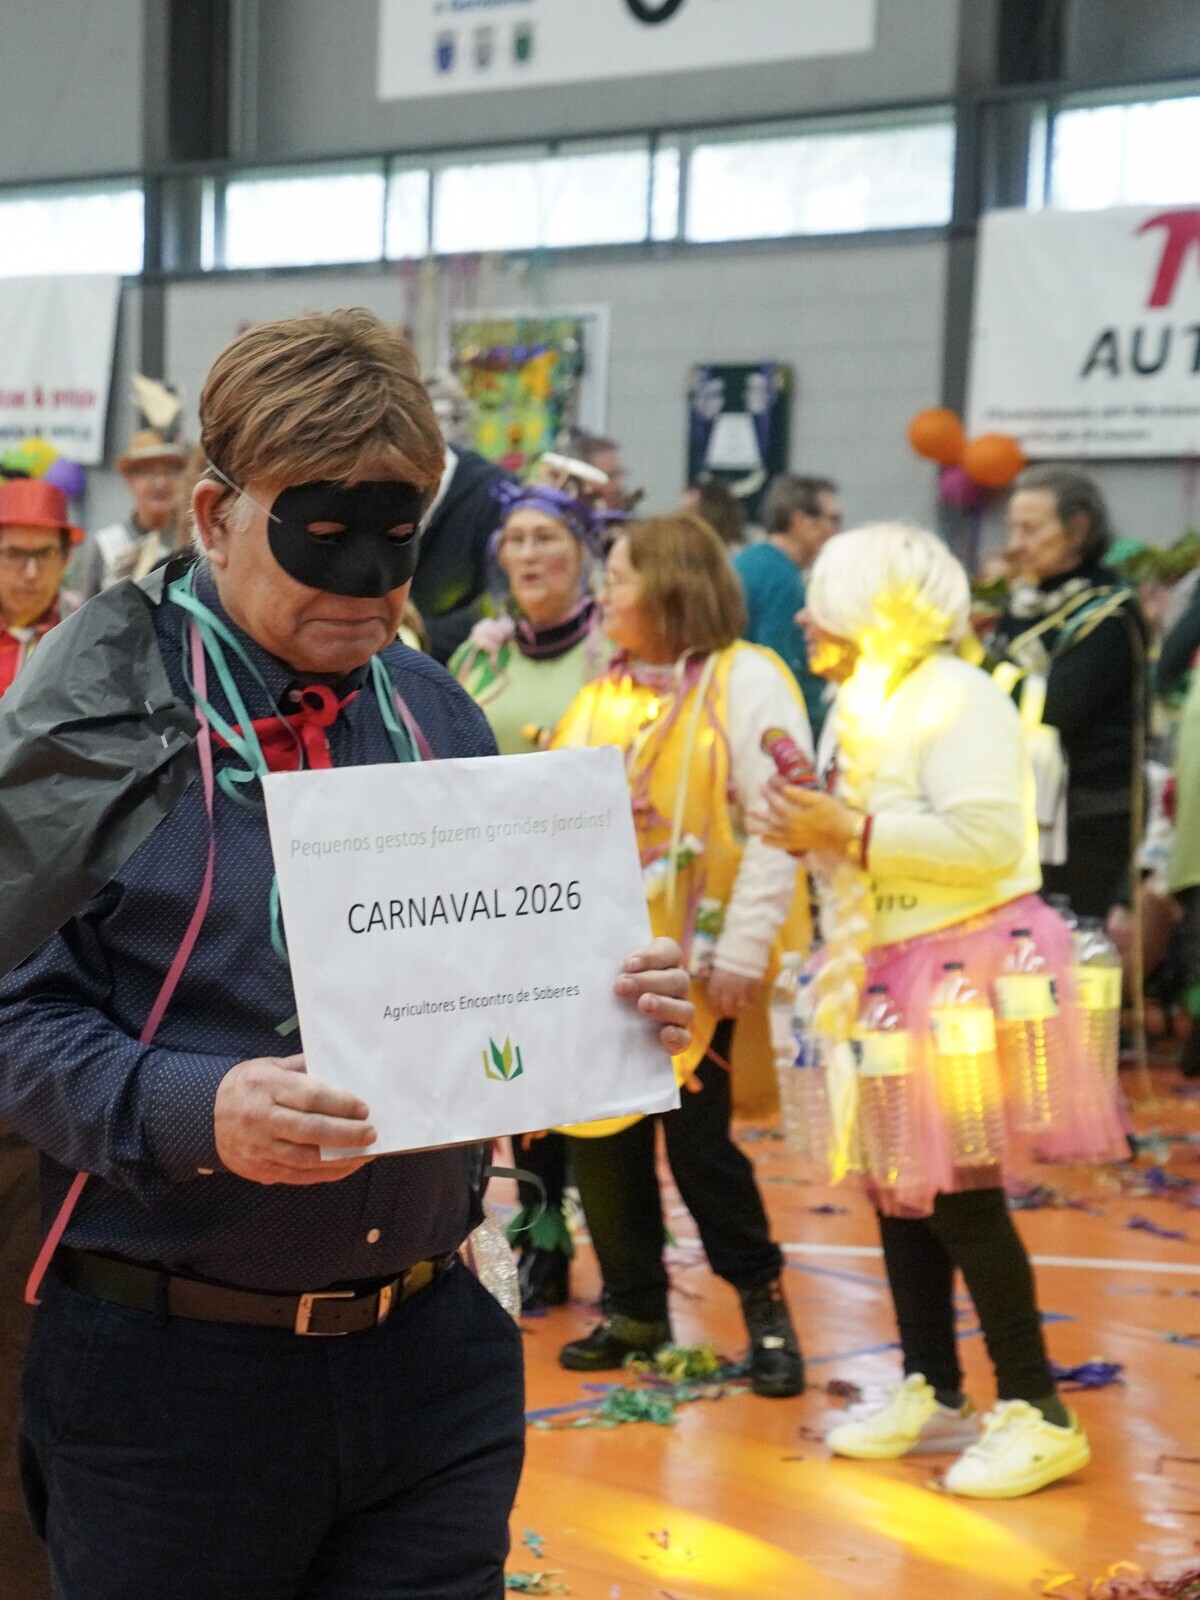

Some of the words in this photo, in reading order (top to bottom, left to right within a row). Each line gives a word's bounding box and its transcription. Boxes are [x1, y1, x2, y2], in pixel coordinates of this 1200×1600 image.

[291, 834, 371, 859] Pequenos
[375, 830, 427, 853] gestos
[431, 824, 481, 849] fazem
[485, 816, 548, 842] grandes
[551, 808, 612, 836] jardins!
[348, 888, 507, 934] CARNAVAL
[514, 880, 582, 917] 2026
[383, 999, 456, 1021] Agricultores
[459, 992, 513, 1010] Encontro
[516, 988, 530, 1003] de
[533, 984, 581, 1001] Saberes
